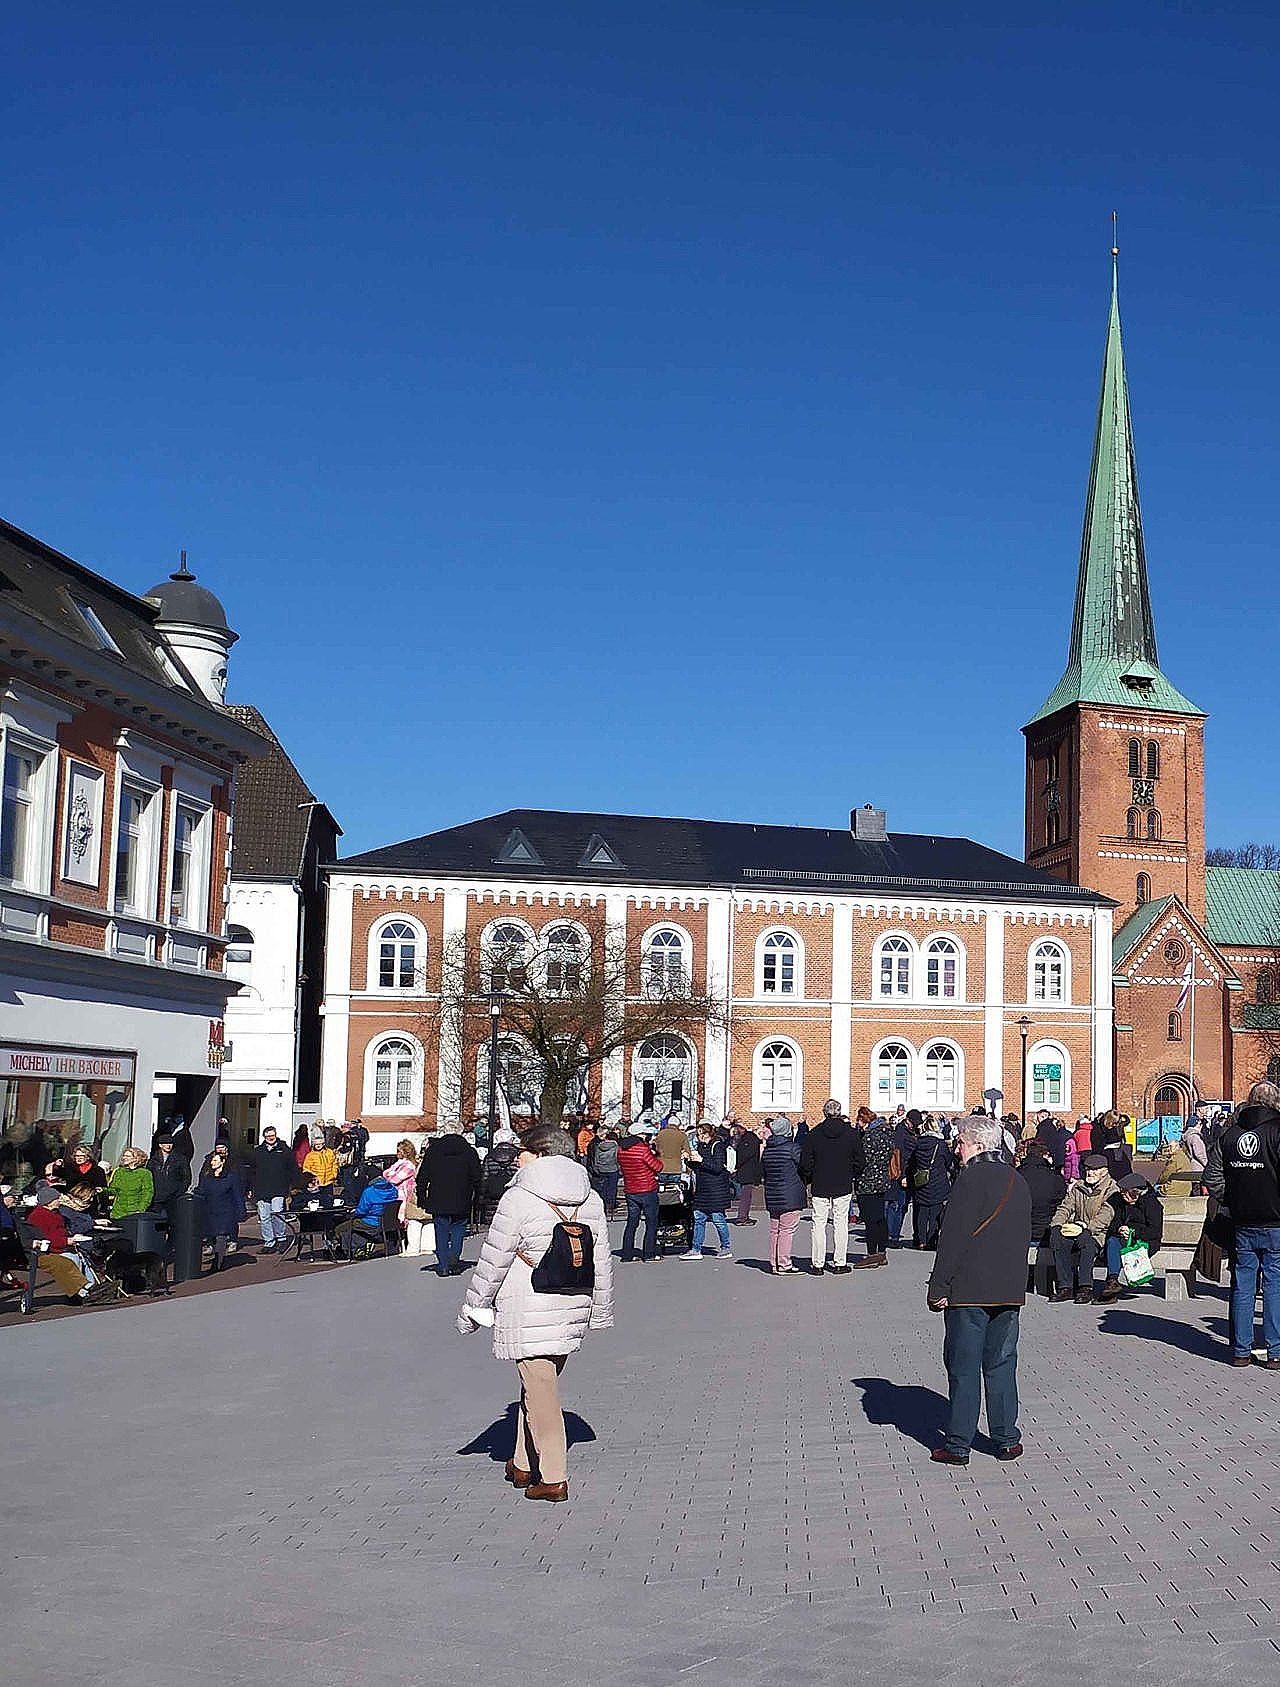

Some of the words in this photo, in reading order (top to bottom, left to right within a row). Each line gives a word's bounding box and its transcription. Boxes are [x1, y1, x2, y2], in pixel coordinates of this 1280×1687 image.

[10, 1054, 52, 1072] MICHELY
[56, 1057, 76, 1073] IHR
[79, 1058, 121, 1076] BÄCKER
[1238, 1132, 1260, 1159] VW
